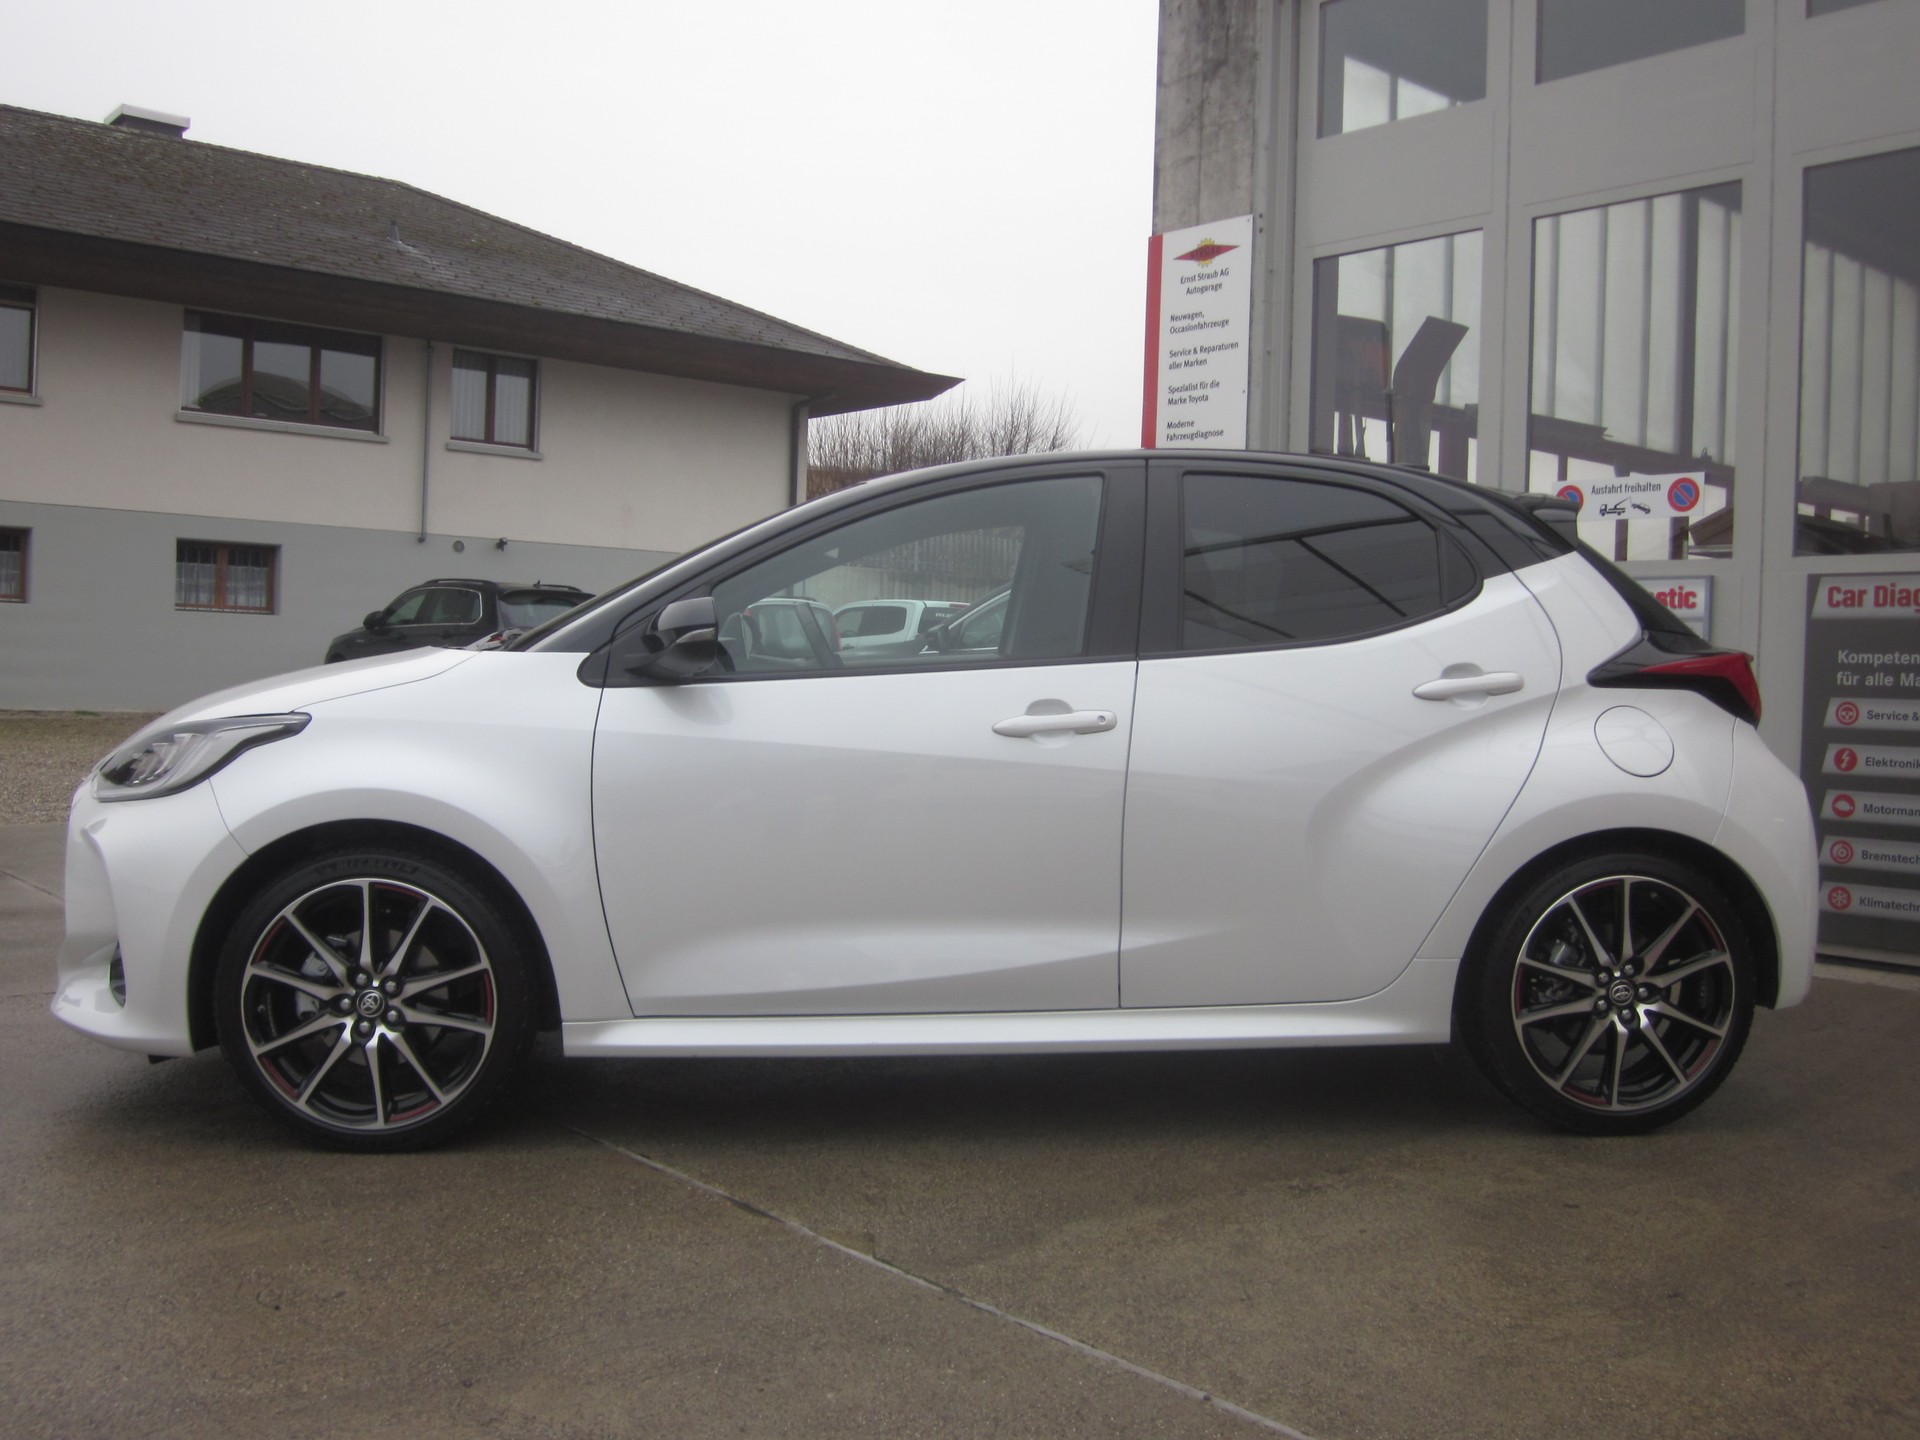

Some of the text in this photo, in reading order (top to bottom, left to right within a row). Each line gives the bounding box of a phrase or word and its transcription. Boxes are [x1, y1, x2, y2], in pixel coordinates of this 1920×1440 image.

[1180, 267, 1230, 284] Ernst Straub AG
[1185, 283, 1223, 296] Autogarage
[1170, 311, 1205, 322] Neuwagen,
[1169, 319, 1230, 335] Occasionfahrzeuge
[1169, 341, 1239, 359] Service & Reparaturen
[1168, 357, 1208, 370] aller Marken
[1168, 380, 1220, 395] Spezialist für die
[1167, 394, 1209, 406] Marke Toyota
[1166, 420, 1195, 430] Moderne
[1166, 429, 1224, 441] Fahrzeugdiagnose
[1590, 482, 1661, 495] Ausfahrt freihalten
[1653, 585, 1697, 609] stic
[1827, 586, 1867, 608] Car
[1838, 650, 1920, 667] Kompeten
[1837, 672, 1860, 686] für
[1865, 673, 1894, 686] alle
[1867, 710, 1919, 721] Service &
[1863, 804, 1920, 817] Motorman
